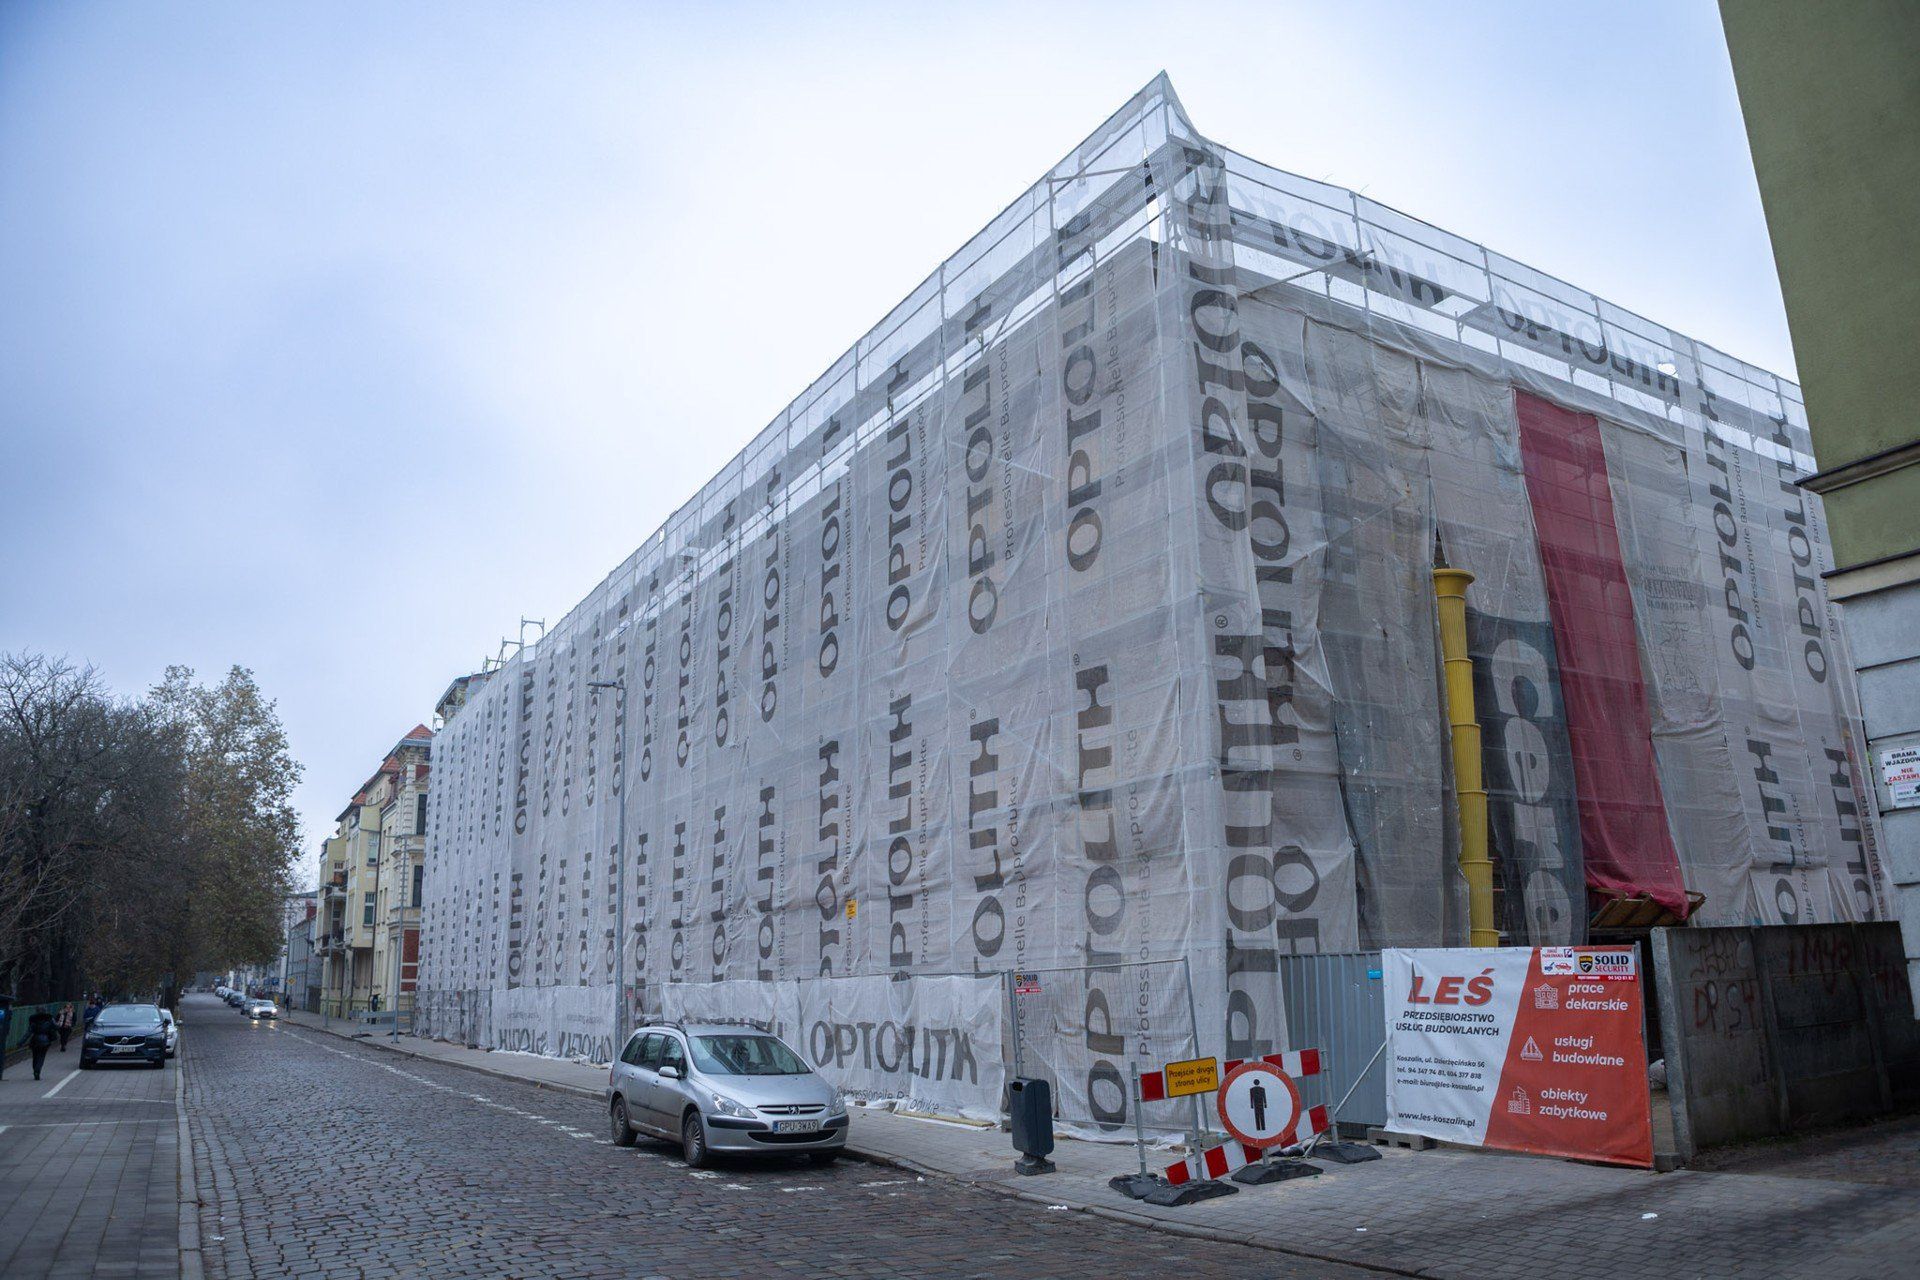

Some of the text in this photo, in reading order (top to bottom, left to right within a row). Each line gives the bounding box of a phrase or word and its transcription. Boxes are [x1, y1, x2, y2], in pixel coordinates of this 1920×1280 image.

[1885, 757, 1920, 766] WJAZDOW
[1594, 955, 1629, 965] SOLID
[1407, 968, 1494, 1006] LEŚ
[1568, 982, 1605, 995] prace
[1565, 998, 1629, 1012] dekarskie
[1403, 1010, 1495, 1024] PRZEDSIĘBIORSTWO
[1395, 1022, 1499, 1037] USŁUG BUDOWLANYCH
[1554, 1036, 1594, 1050] usługi
[1397, 1055, 1424, 1063] Koszalin,
[1553, 1053, 1625, 1067] budowlane
[1541, 1088, 1588, 1103] obiekty
[1539, 1104, 1607, 1121] zabytkowe
[1398, 1112, 1476, 1128] www.les-koszalin.pl
